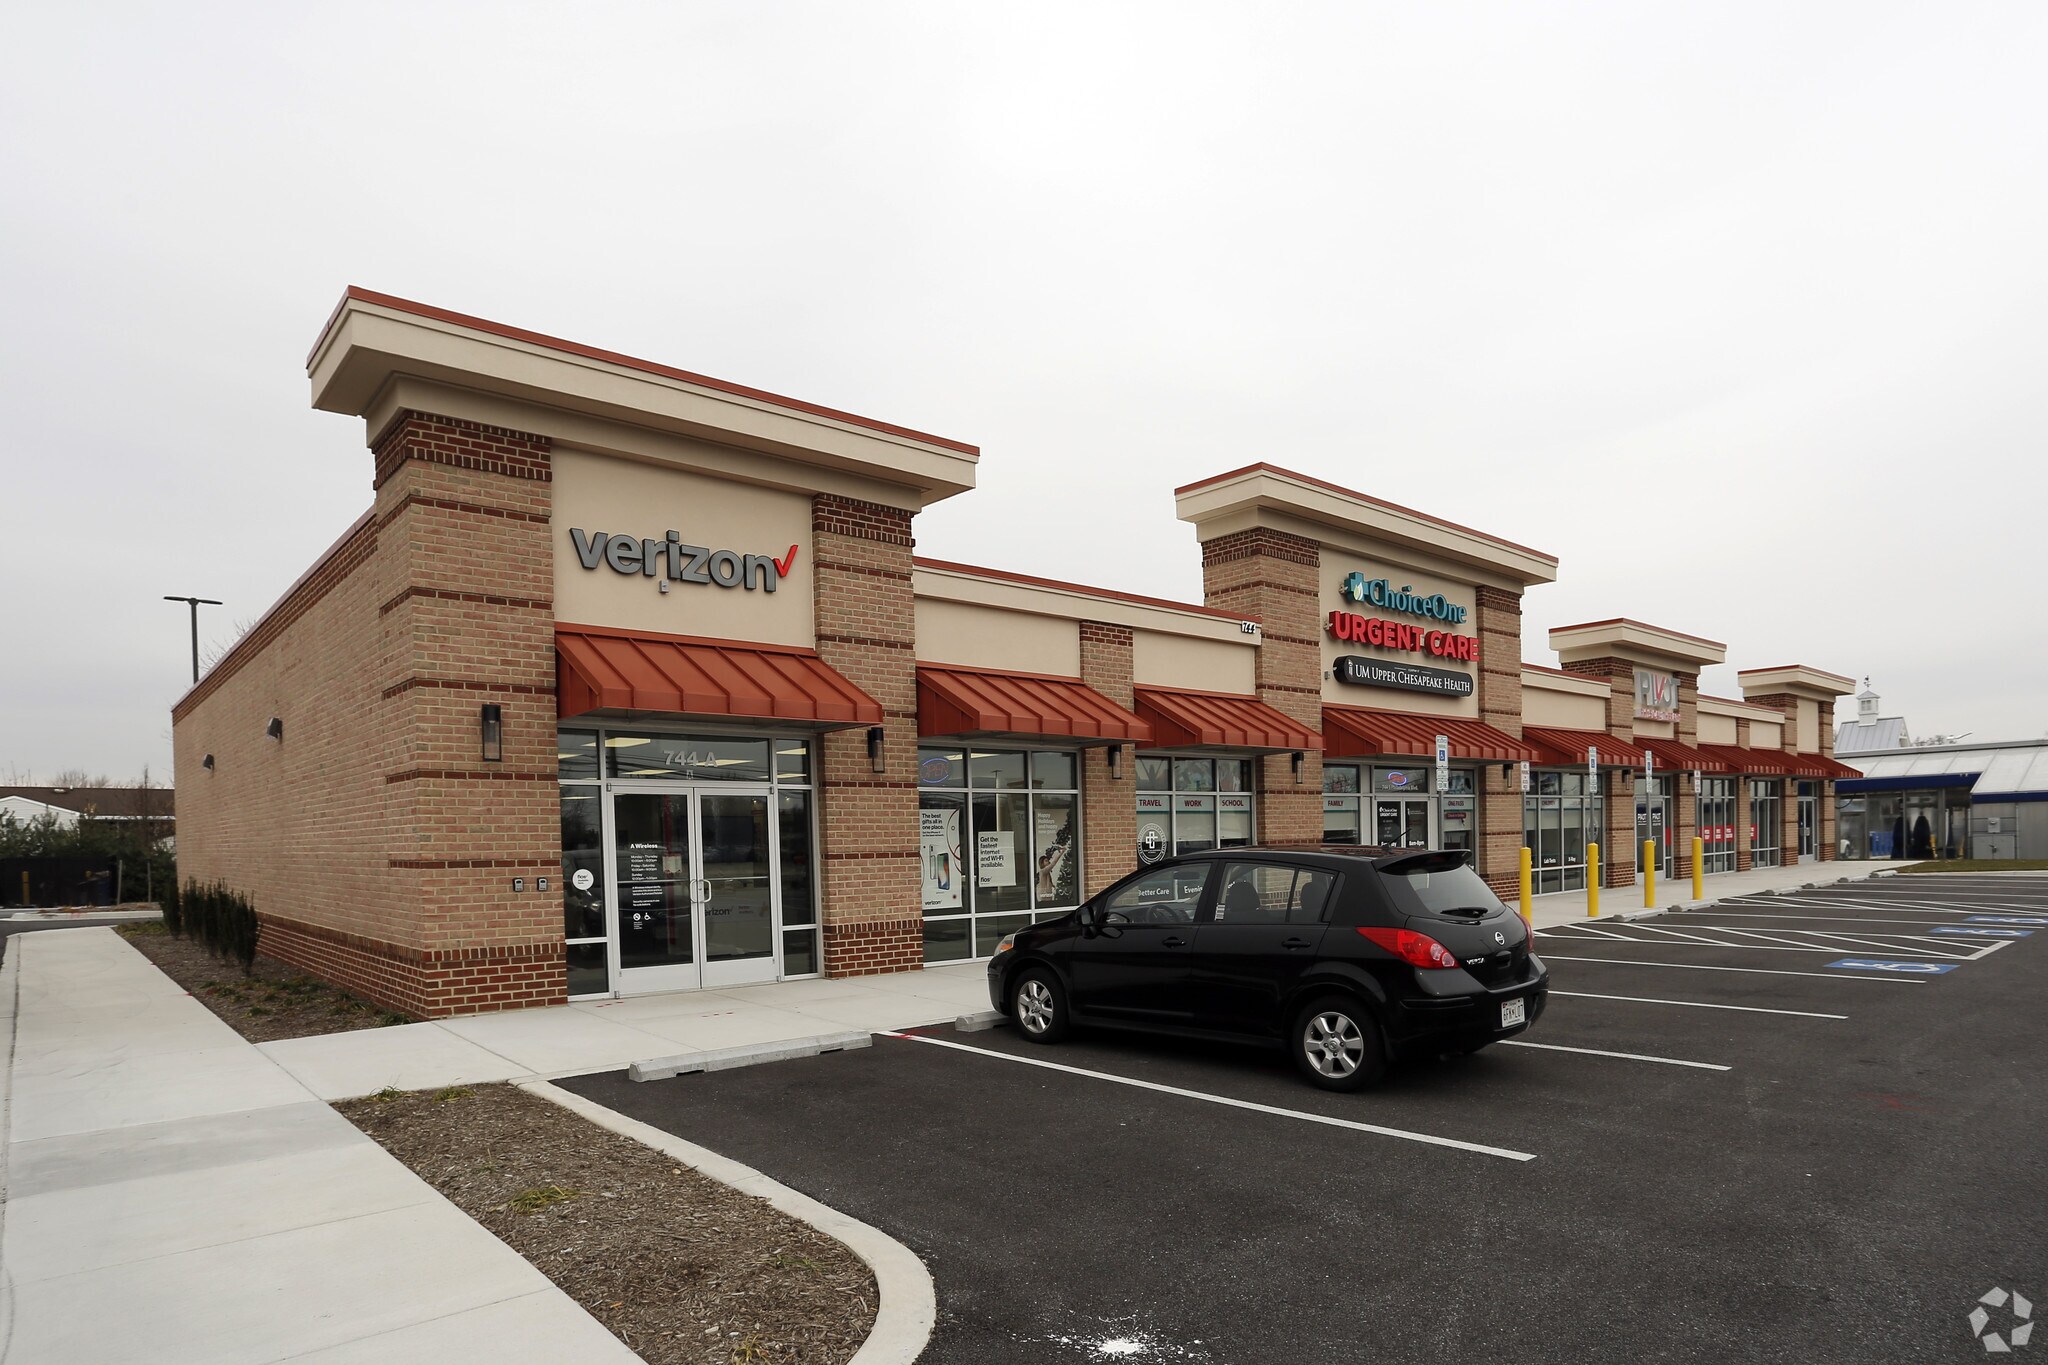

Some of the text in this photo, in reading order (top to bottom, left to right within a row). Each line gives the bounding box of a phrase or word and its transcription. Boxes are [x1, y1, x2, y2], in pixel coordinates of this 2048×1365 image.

[569, 528, 777, 592] verizon
[1369, 578, 1467, 624] ChoiceOne
[1242, 621, 1256, 634] 744
[1329, 611, 1480, 662] URGENT CARE
[1355, 664, 1370, 679] UM
[1634, 671, 1681, 709] PIVOT
[663, 750, 718, 767] 744 A
